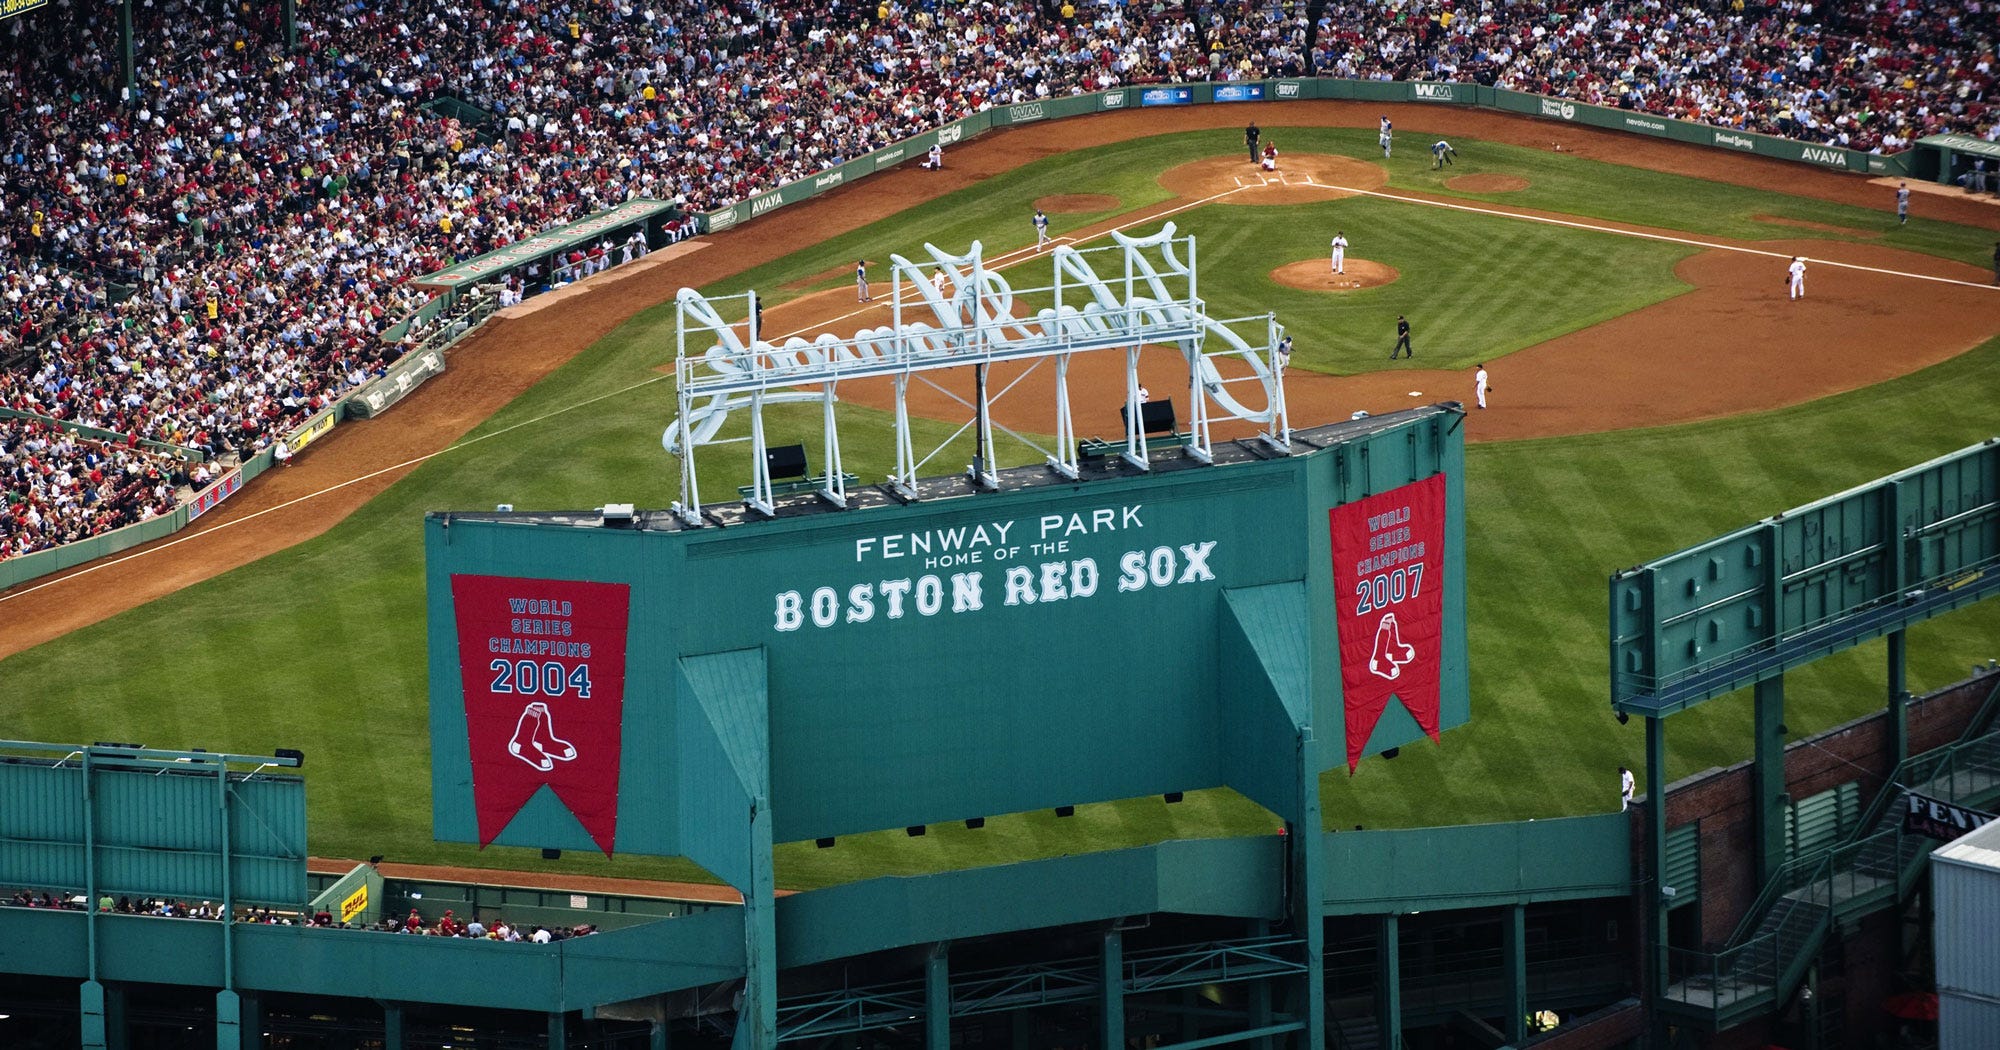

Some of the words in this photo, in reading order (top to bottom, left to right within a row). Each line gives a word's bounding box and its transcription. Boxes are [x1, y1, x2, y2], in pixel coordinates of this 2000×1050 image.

[1801, 147, 1847, 167] AVAYA
[751, 193, 783, 215] AVAYA
[1367, 506, 1410, 532] WORLD
[855, 519, 1015, 563] FENWAY
[1040, 504, 1145, 540] PARK
[1369, 526, 1411, 552] SERIES
[925, 550, 983, 569] HOME
[993, 546, 1021, 561] OF
[1030, 540, 1070, 556] THE
[1357, 541, 1425, 577] CHAMPIONS
[773, 571, 984, 632] BOSTON
[1003, 557, 1100, 606] RED
[1117, 540, 1218, 593] SOX
[1356, 562, 1424, 616] 2007
[508, 598, 573, 616] WORLD
[511, 618, 573, 636] SERIES
[488, 637, 592, 658] CHAMPIONS
[490, 658, 592, 699] 2004
[343, 893, 365, 918] DHL
